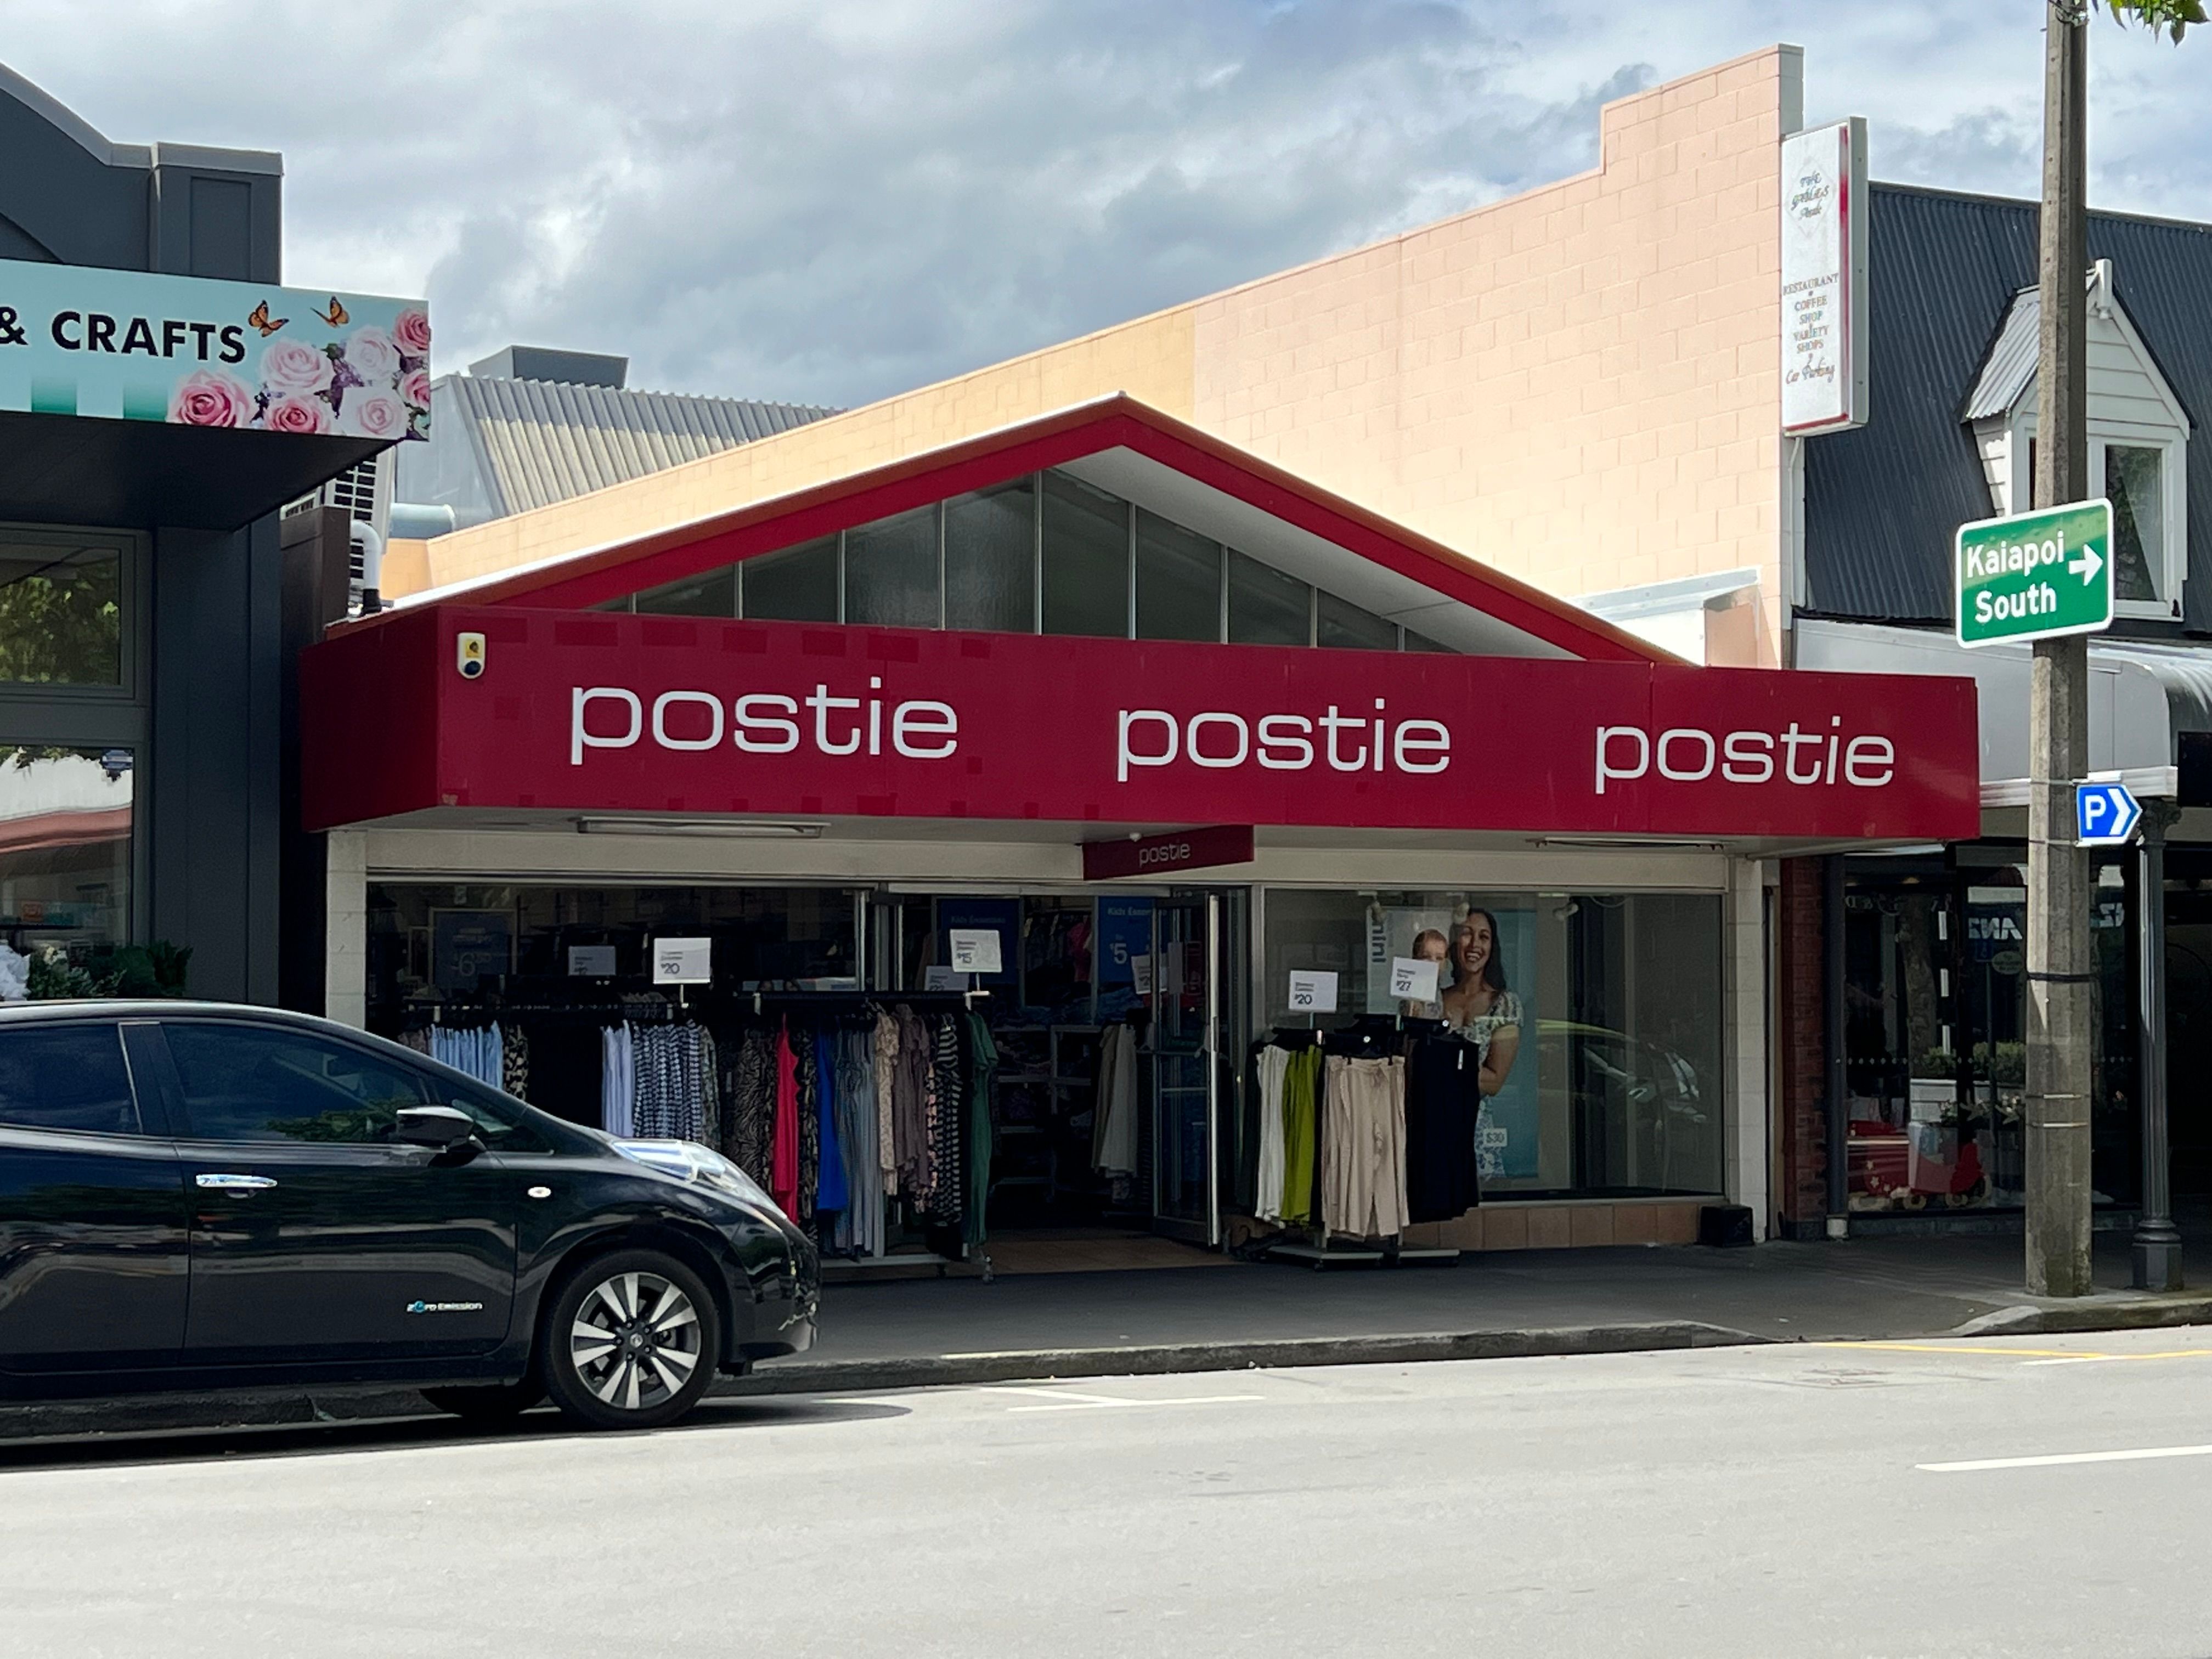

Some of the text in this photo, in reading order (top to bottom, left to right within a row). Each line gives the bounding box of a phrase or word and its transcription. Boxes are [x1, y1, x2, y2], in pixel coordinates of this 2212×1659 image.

[1782, 273, 1839, 296] RESTAURANT
[1794, 295, 1828, 311] COFFEE
[1793, 325, 1830, 341] VARIETY
[1799, 311, 1823, 325] SHOP
[52, 311, 246, 364] CRAFTS
[1797, 338, 1824, 354] SHOPS
[1967, 531, 2064, 578] Kaiapoi
[1975, 582, 2057, 624] South
[571, 676, 958, 765] postie
[1117, 698, 1450, 782] postie
[1595, 716, 1894, 794] postie
[2085, 794, 2107, 831] P
[1139, 841, 1191, 867] postie
